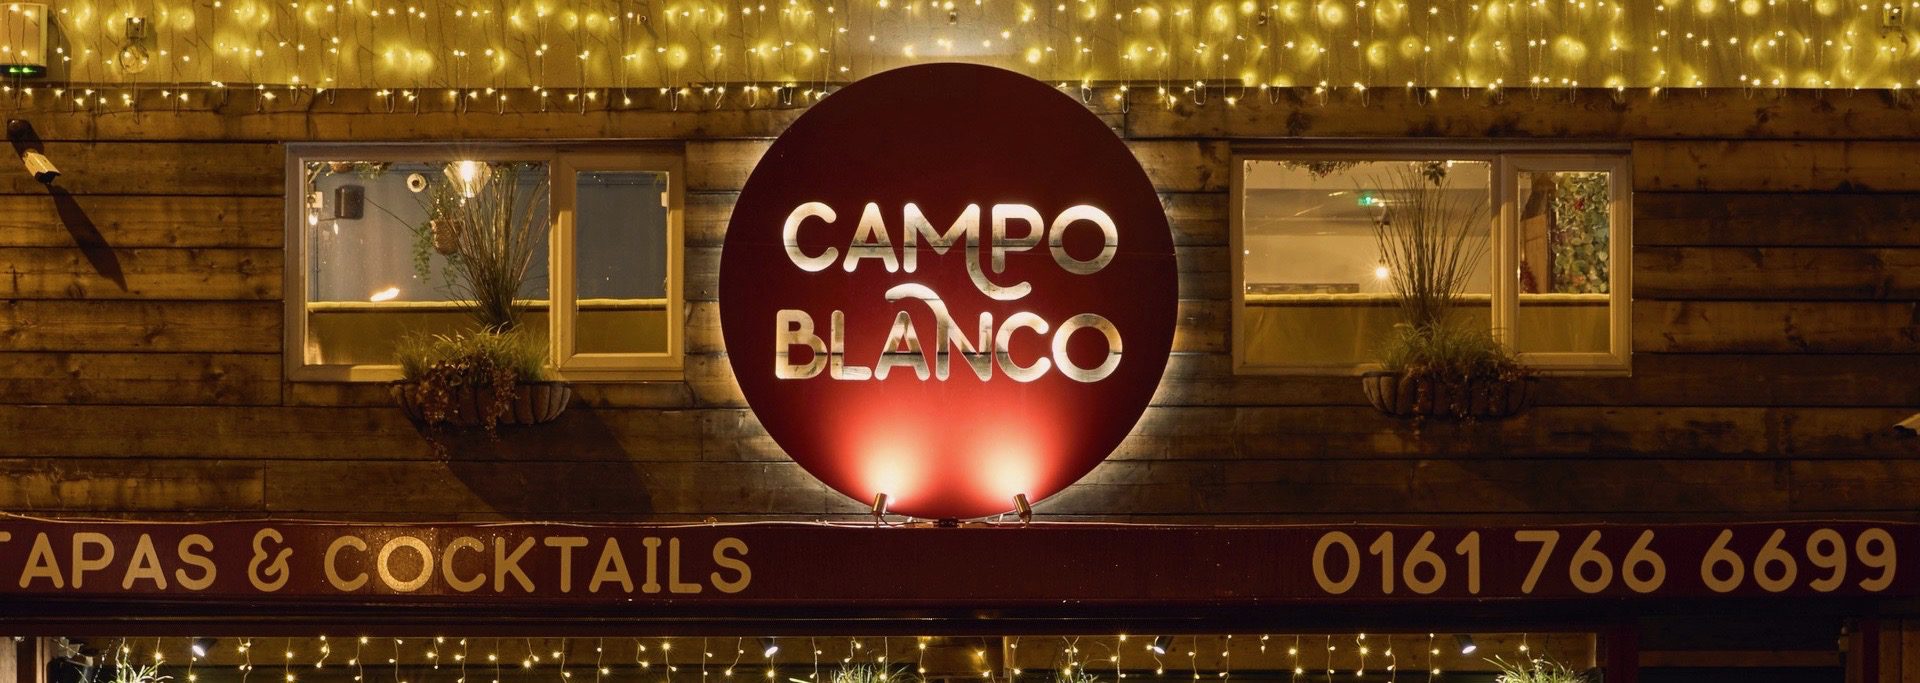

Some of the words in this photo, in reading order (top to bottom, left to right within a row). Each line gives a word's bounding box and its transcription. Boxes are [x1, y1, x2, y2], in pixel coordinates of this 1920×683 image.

[782, 201, 1119, 301] CAMPO
[775, 282, 1123, 384] BLANCO
[248, 528, 293, 592] &
[324, 530, 752, 595] COCKTAILS
[1312, 530, 1480, 595] 0161
[1514, 529, 1666, 594] 766
[1701, 528, 1897, 593] 6699
